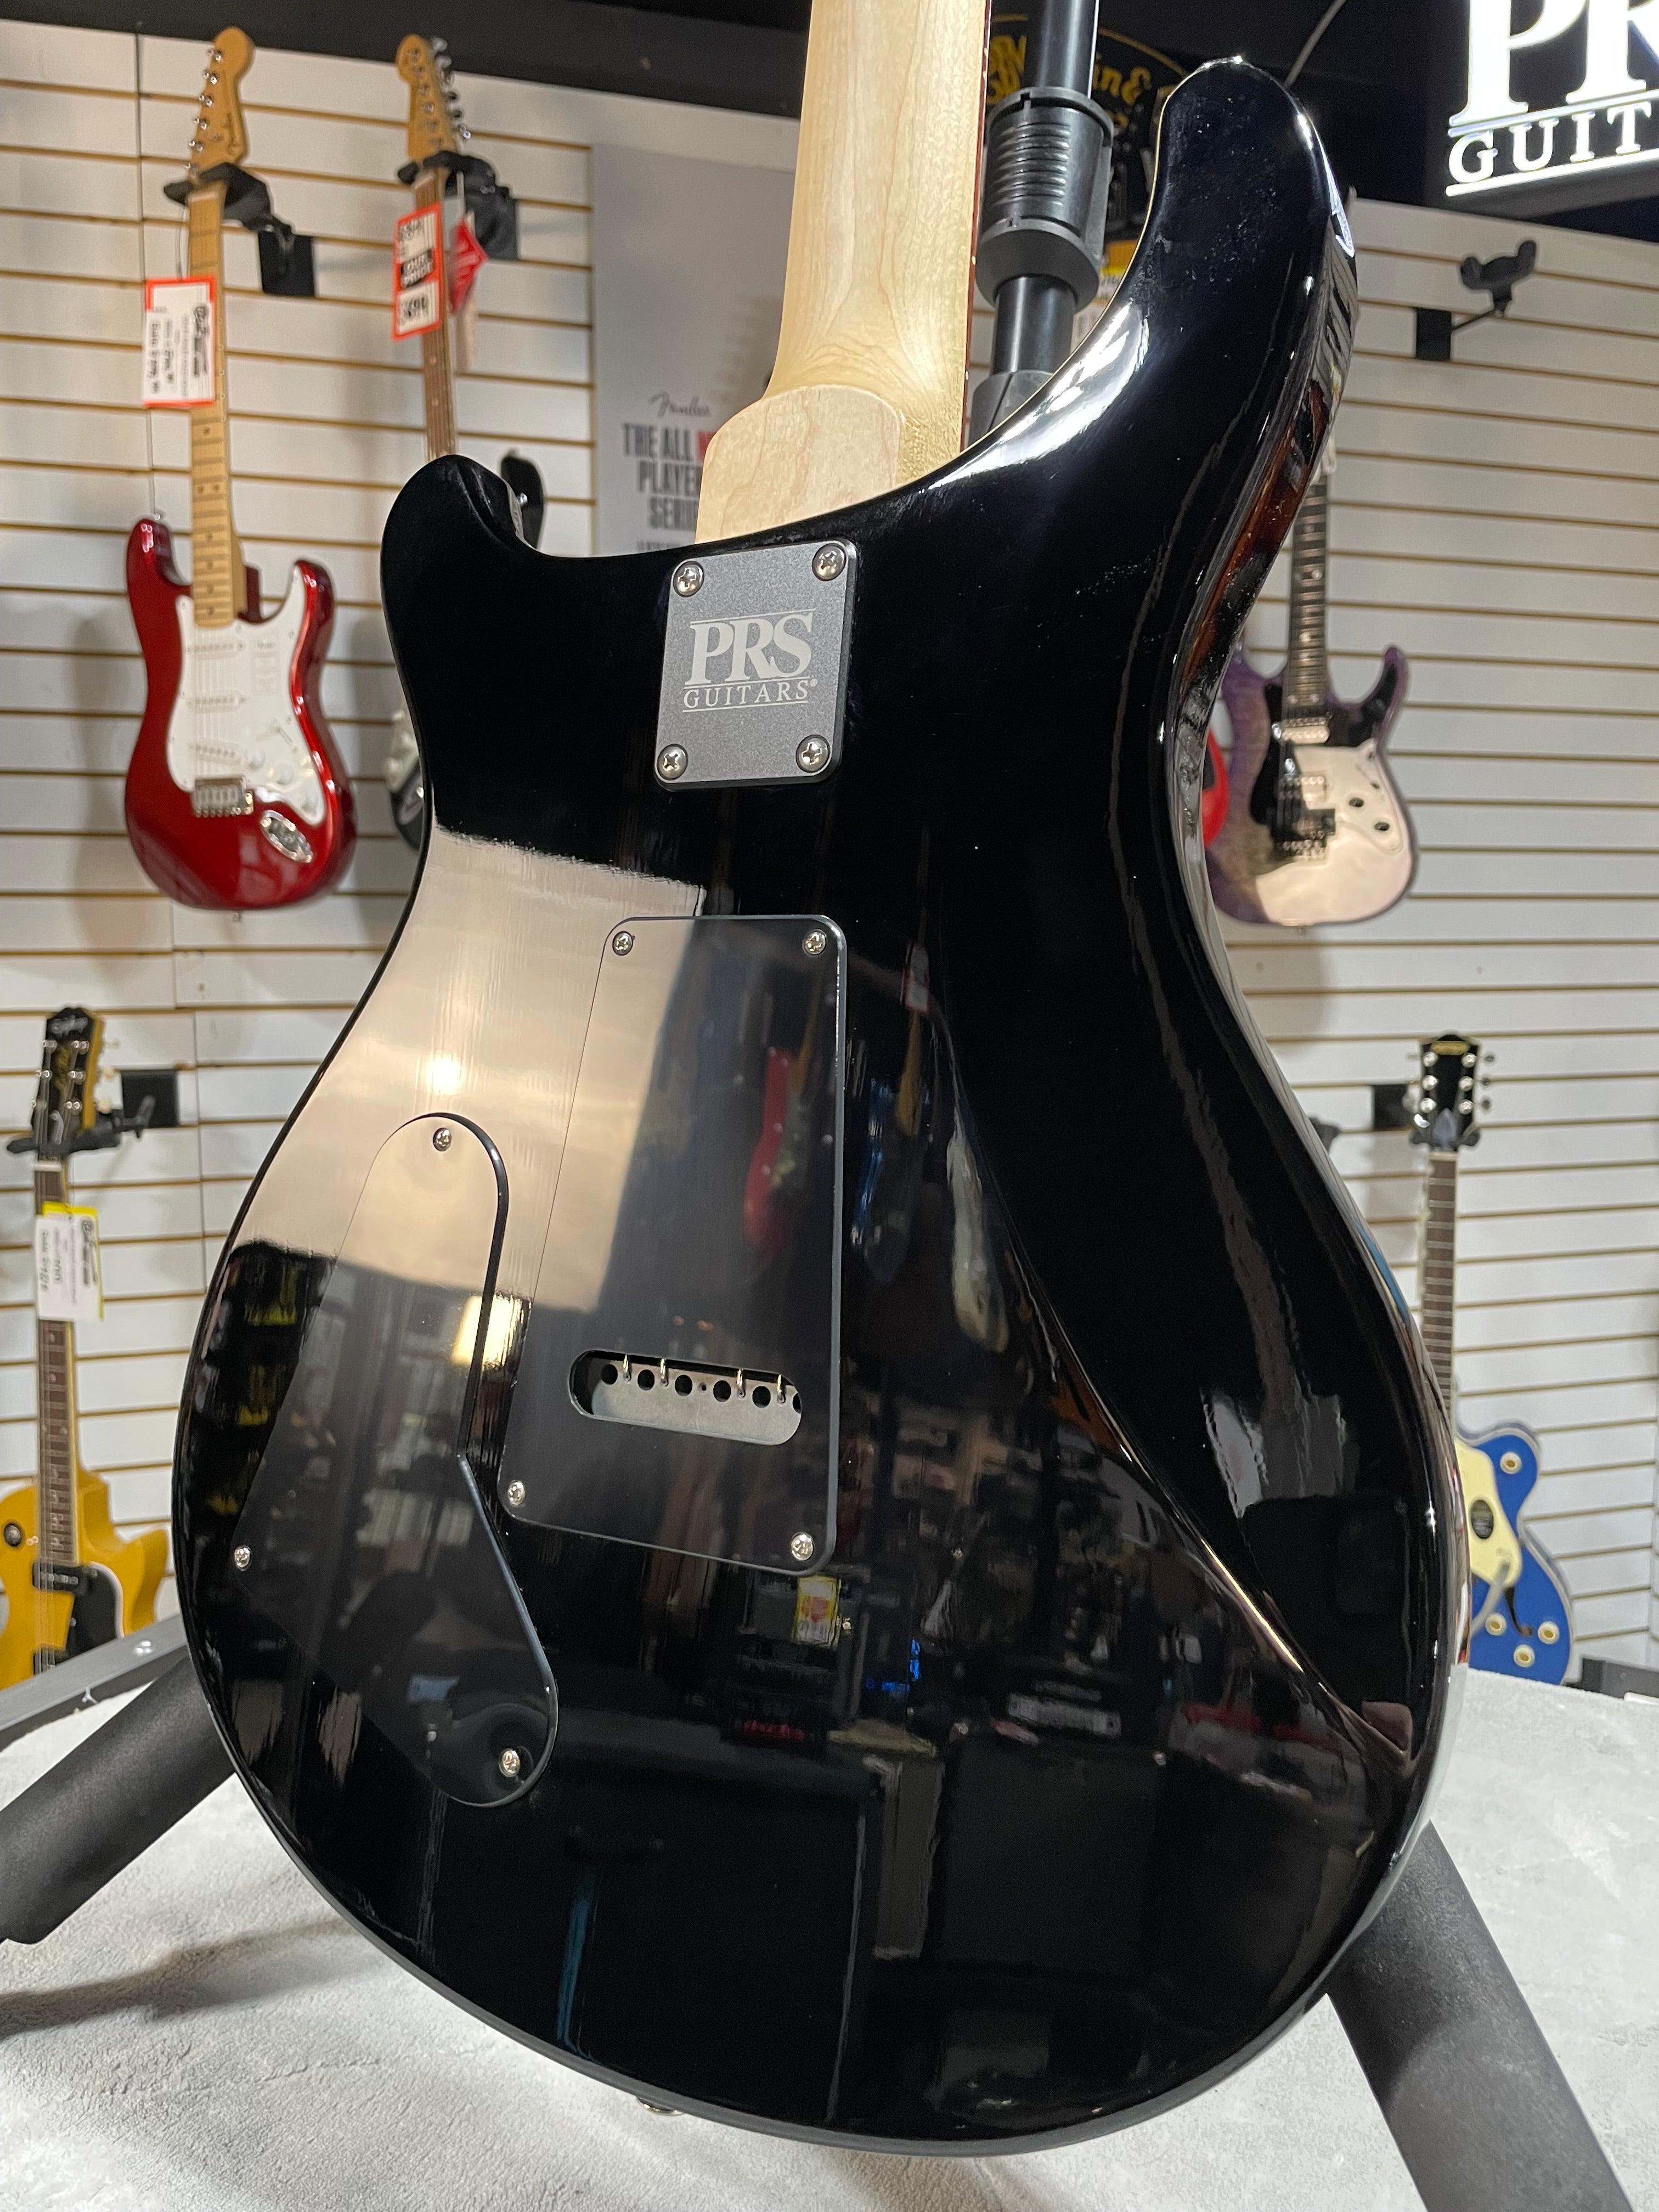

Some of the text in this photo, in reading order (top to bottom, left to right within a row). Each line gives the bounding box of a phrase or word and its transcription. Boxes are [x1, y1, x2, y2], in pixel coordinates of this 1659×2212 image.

[1449, 101, 1652, 184] GUIT
[623, 422, 658, 458] THE
[660, 427, 693, 462] ALL
[685, 612, 814, 685] PRS
[684, 679, 809, 708] GUITARS
